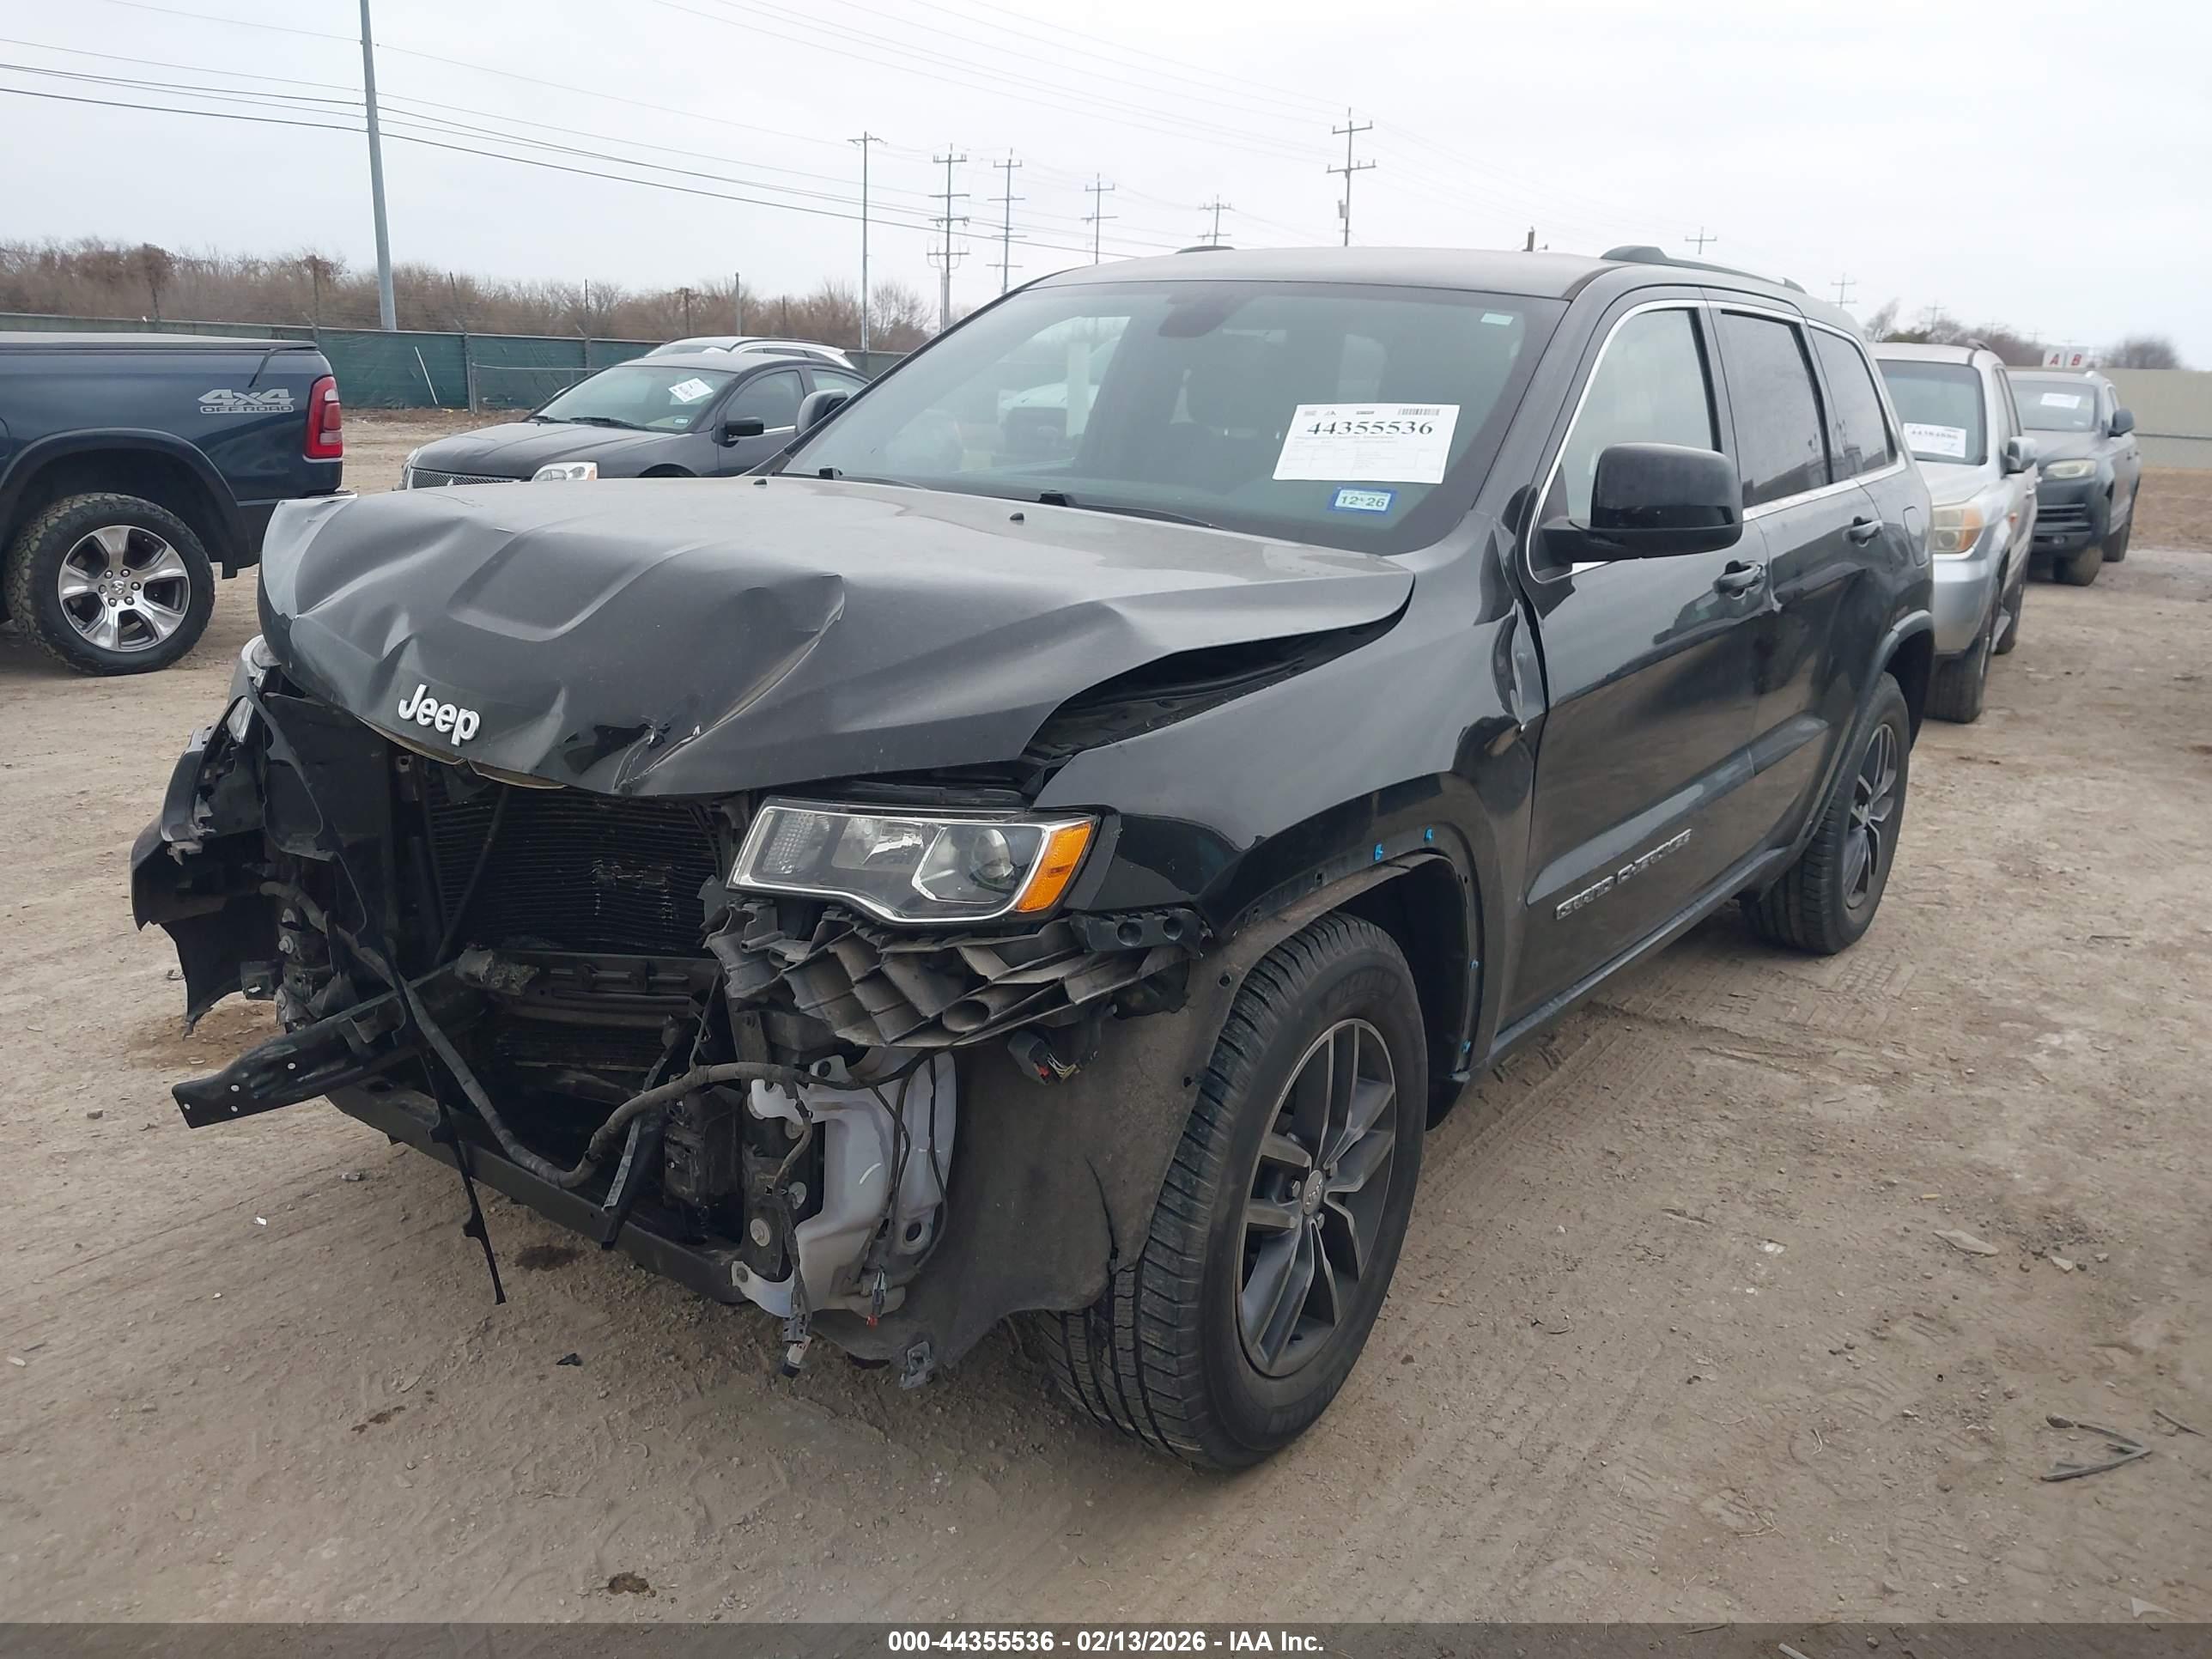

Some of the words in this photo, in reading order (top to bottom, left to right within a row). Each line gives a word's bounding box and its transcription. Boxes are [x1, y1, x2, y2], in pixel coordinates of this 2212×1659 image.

[1306, 421, 1434, 436] 44355536
[1340, 495, 1359, 506] 12
[1365, 496, 1387, 507] 26
[398, 683, 481, 747] Jeep
